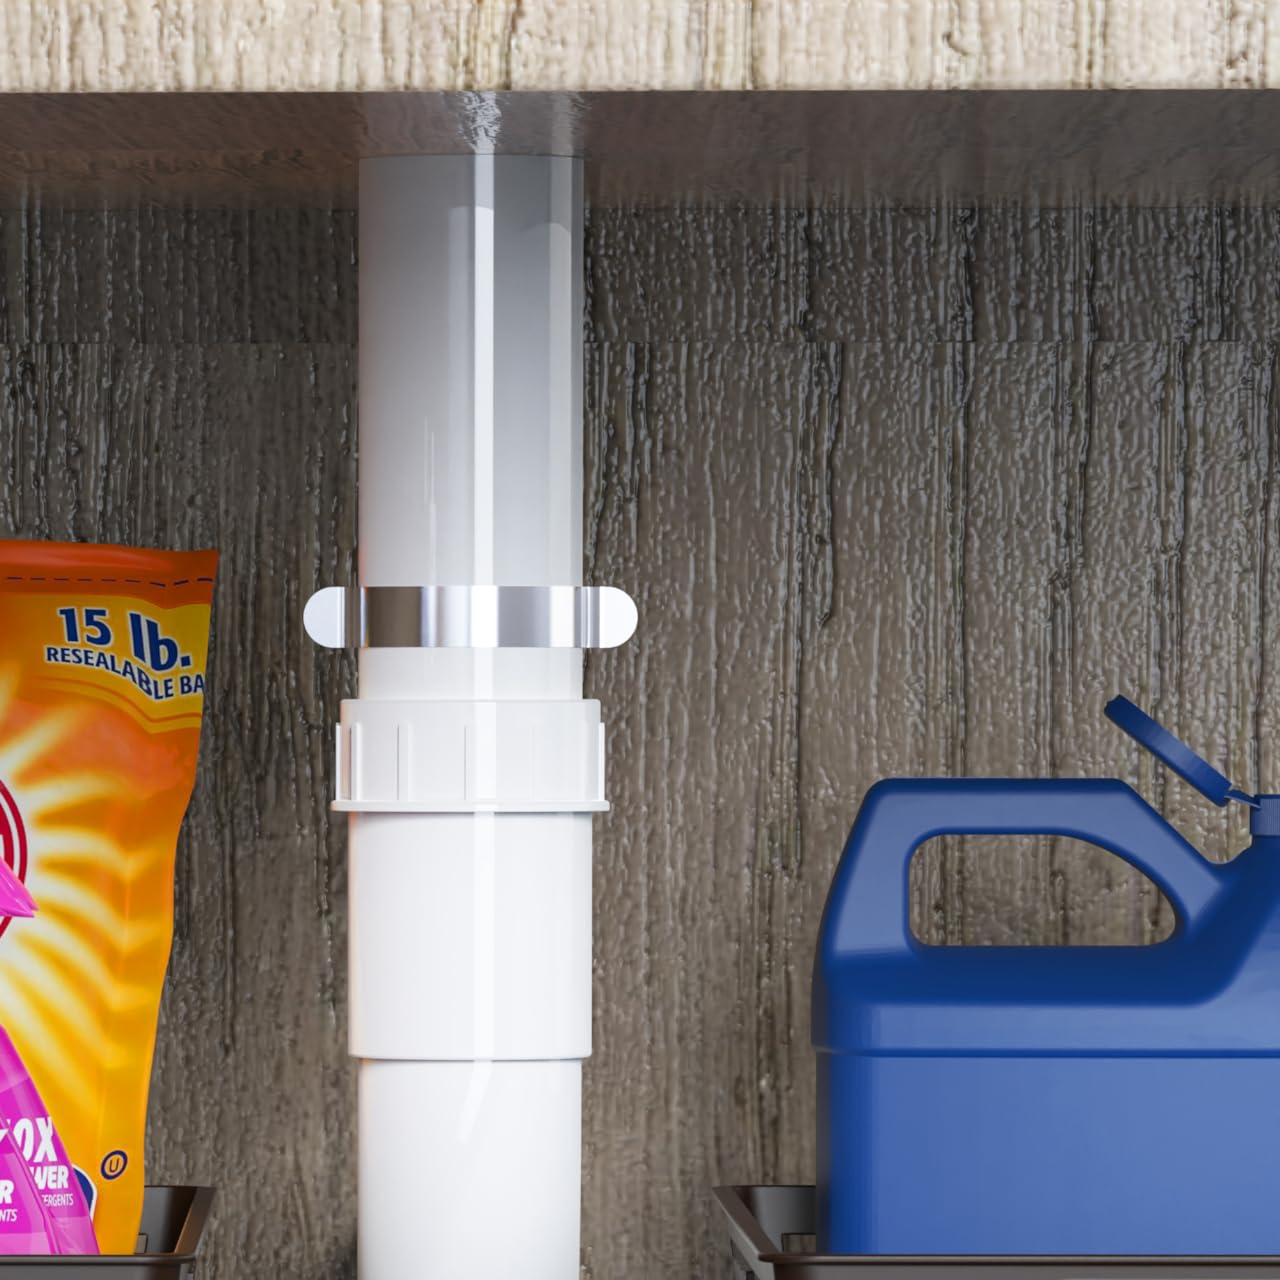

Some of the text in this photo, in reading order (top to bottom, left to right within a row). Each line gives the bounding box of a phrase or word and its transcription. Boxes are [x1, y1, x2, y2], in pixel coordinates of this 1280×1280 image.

[58, 607, 192, 672] 15 lb.
[46, 646, 204, 700] RESEALABLE BA
[31, 1164, 69, 1190] WER
